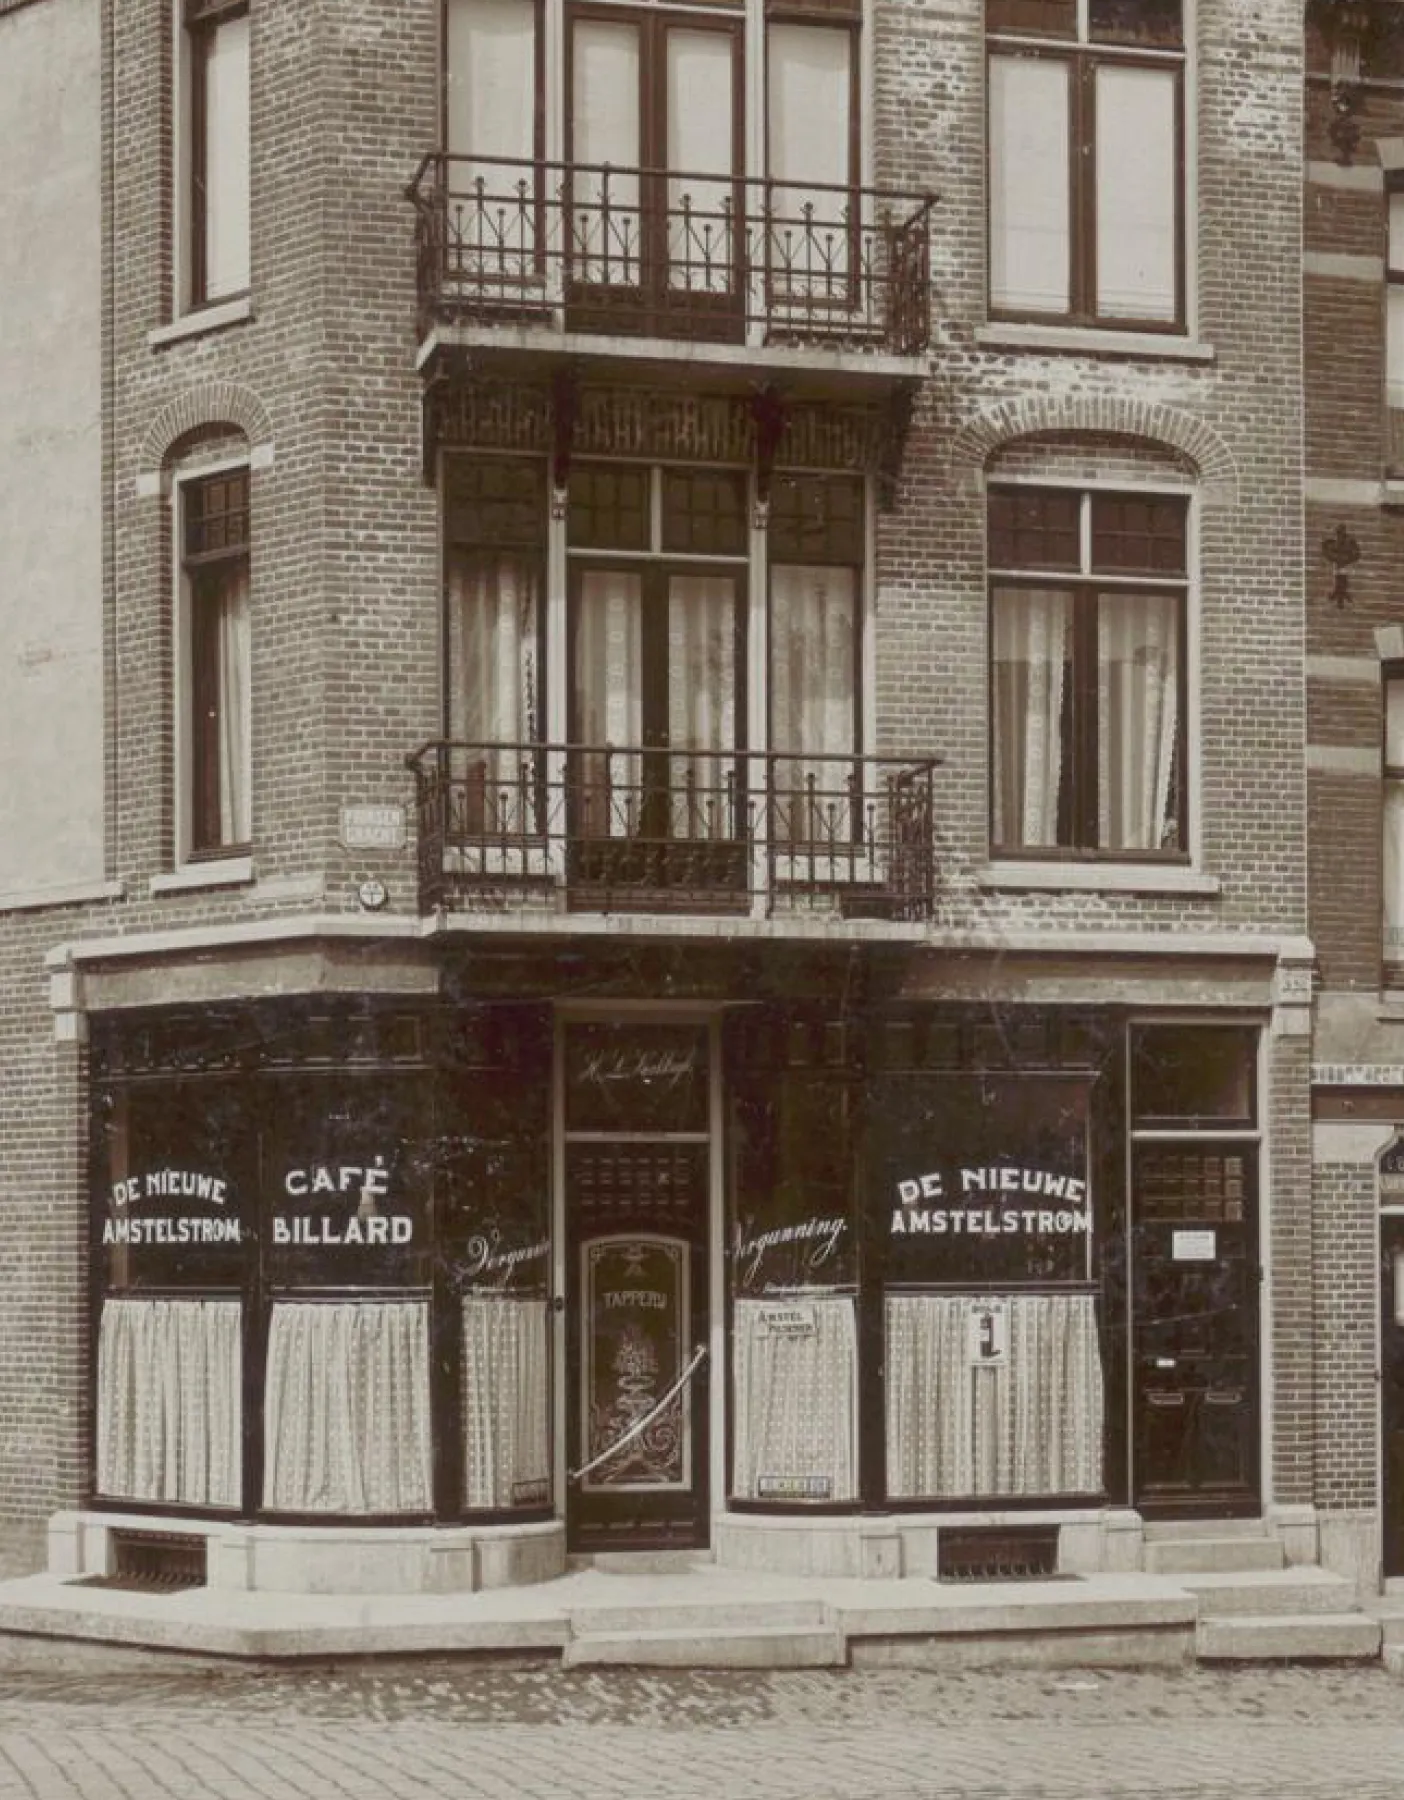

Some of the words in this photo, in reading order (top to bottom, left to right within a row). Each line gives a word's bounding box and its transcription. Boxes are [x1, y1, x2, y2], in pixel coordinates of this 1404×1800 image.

[112, 1176, 141, 1207] DE
[145, 1167, 227, 1205] NIEUWE
[895, 1172, 943, 1205] DE
[961, 1167, 1086, 1203] NIEUWE
[272, 1216, 412, 1244] BILLARD
